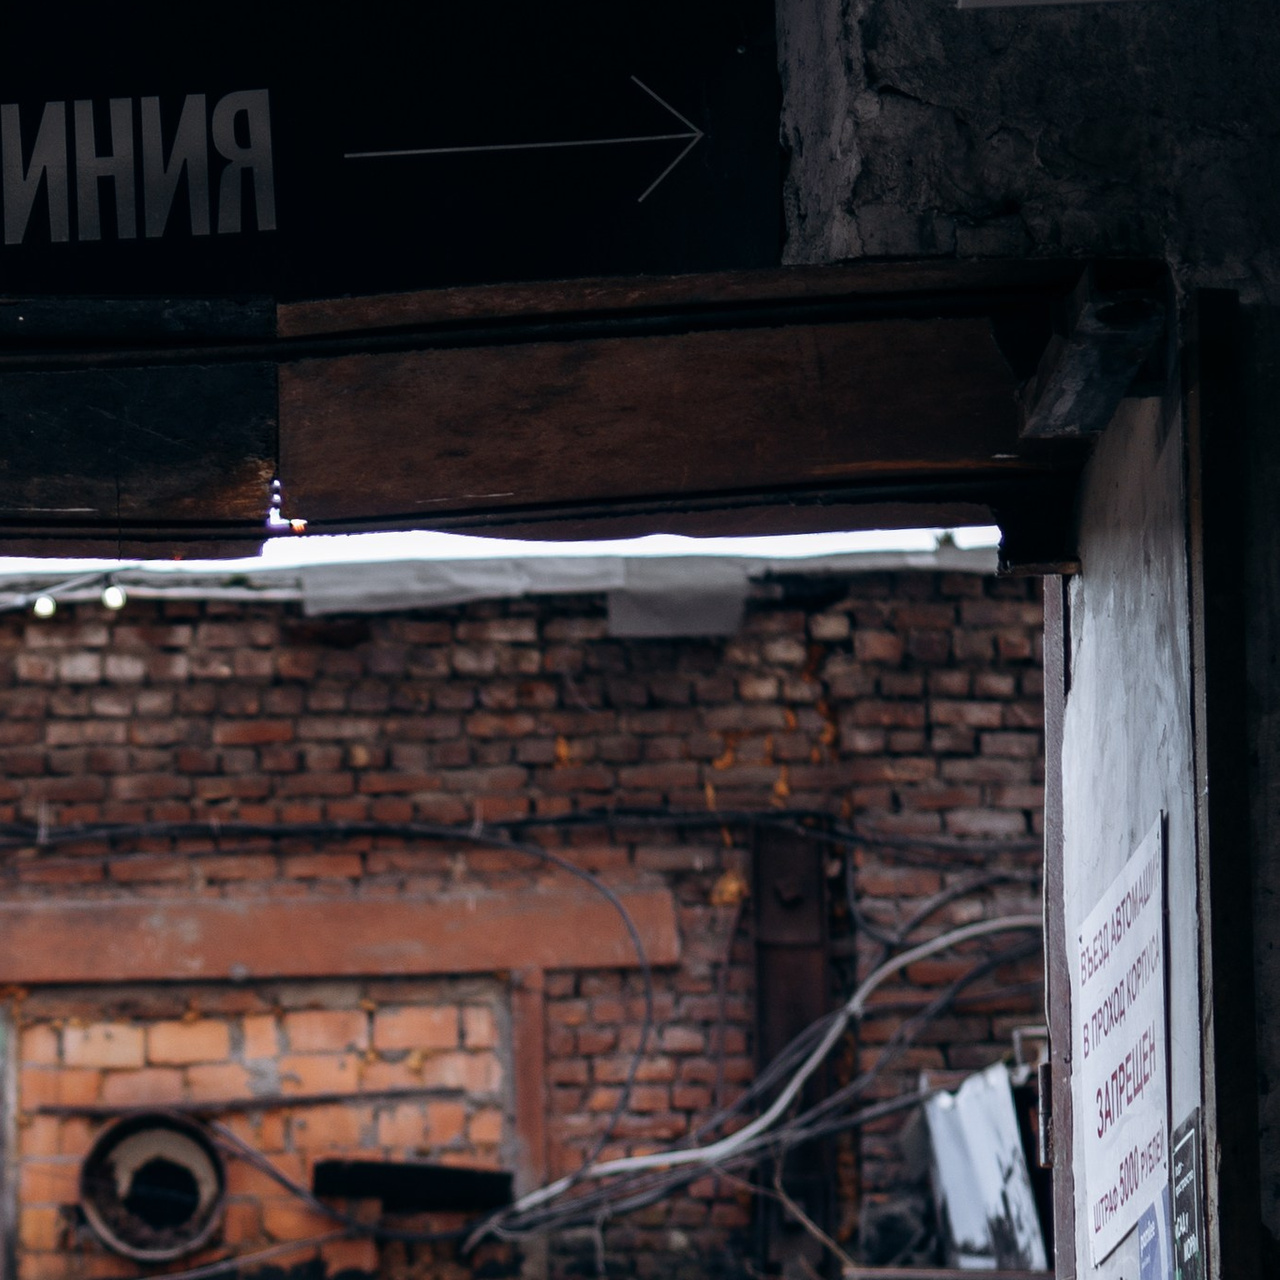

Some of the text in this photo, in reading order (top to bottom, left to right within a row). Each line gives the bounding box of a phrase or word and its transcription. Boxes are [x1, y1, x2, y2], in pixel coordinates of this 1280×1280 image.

[1080, 848, 1161, 987] ВЪЕЗД АВТОМАШИН
[1083, 931, 1161, 1060] В ПРОХОД КОРПУСА
[1096, 1019, 1157, 1139] ЗАПРЕЩЕН
[1093, 1119, 1164, 1235] ШТРАФ 5000 РУБЛЕЙ
